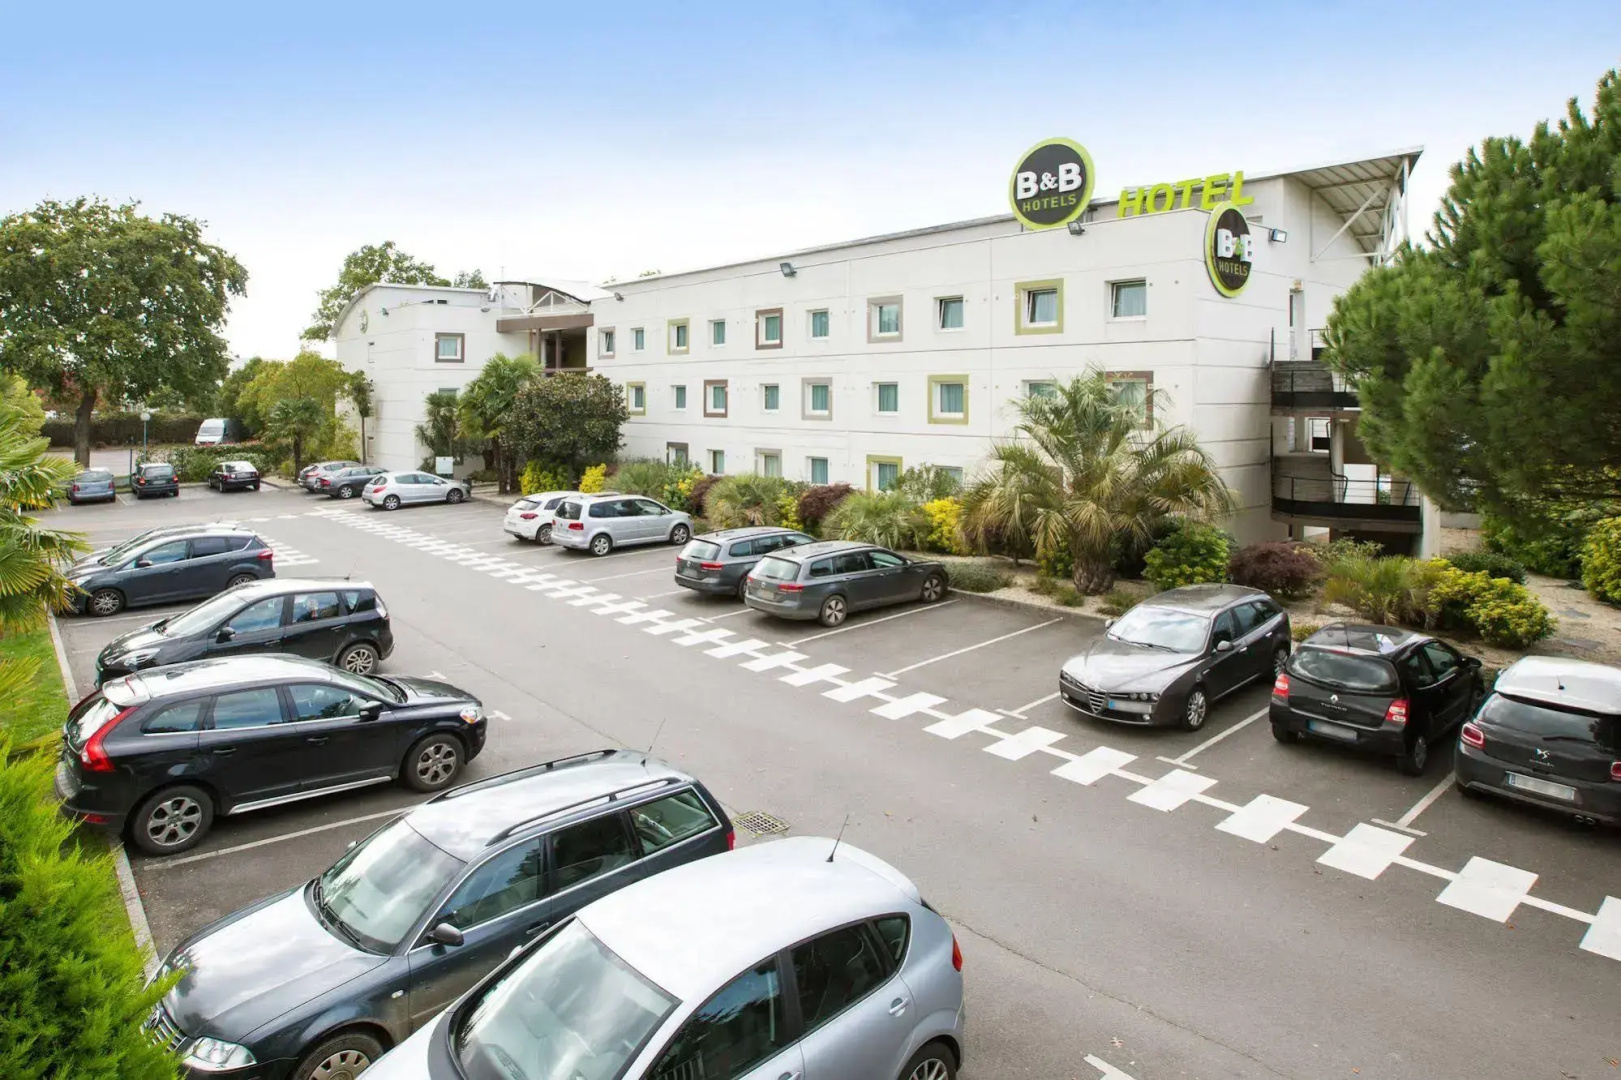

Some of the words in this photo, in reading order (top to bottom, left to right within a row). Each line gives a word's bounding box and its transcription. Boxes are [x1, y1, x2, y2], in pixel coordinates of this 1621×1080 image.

[1017, 162, 1082, 200] B&B
[1116, 170, 1255, 218] HOTEL
[1022, 194, 1077, 213] HOTELS
[1219, 260, 1248, 277] HOTELS
